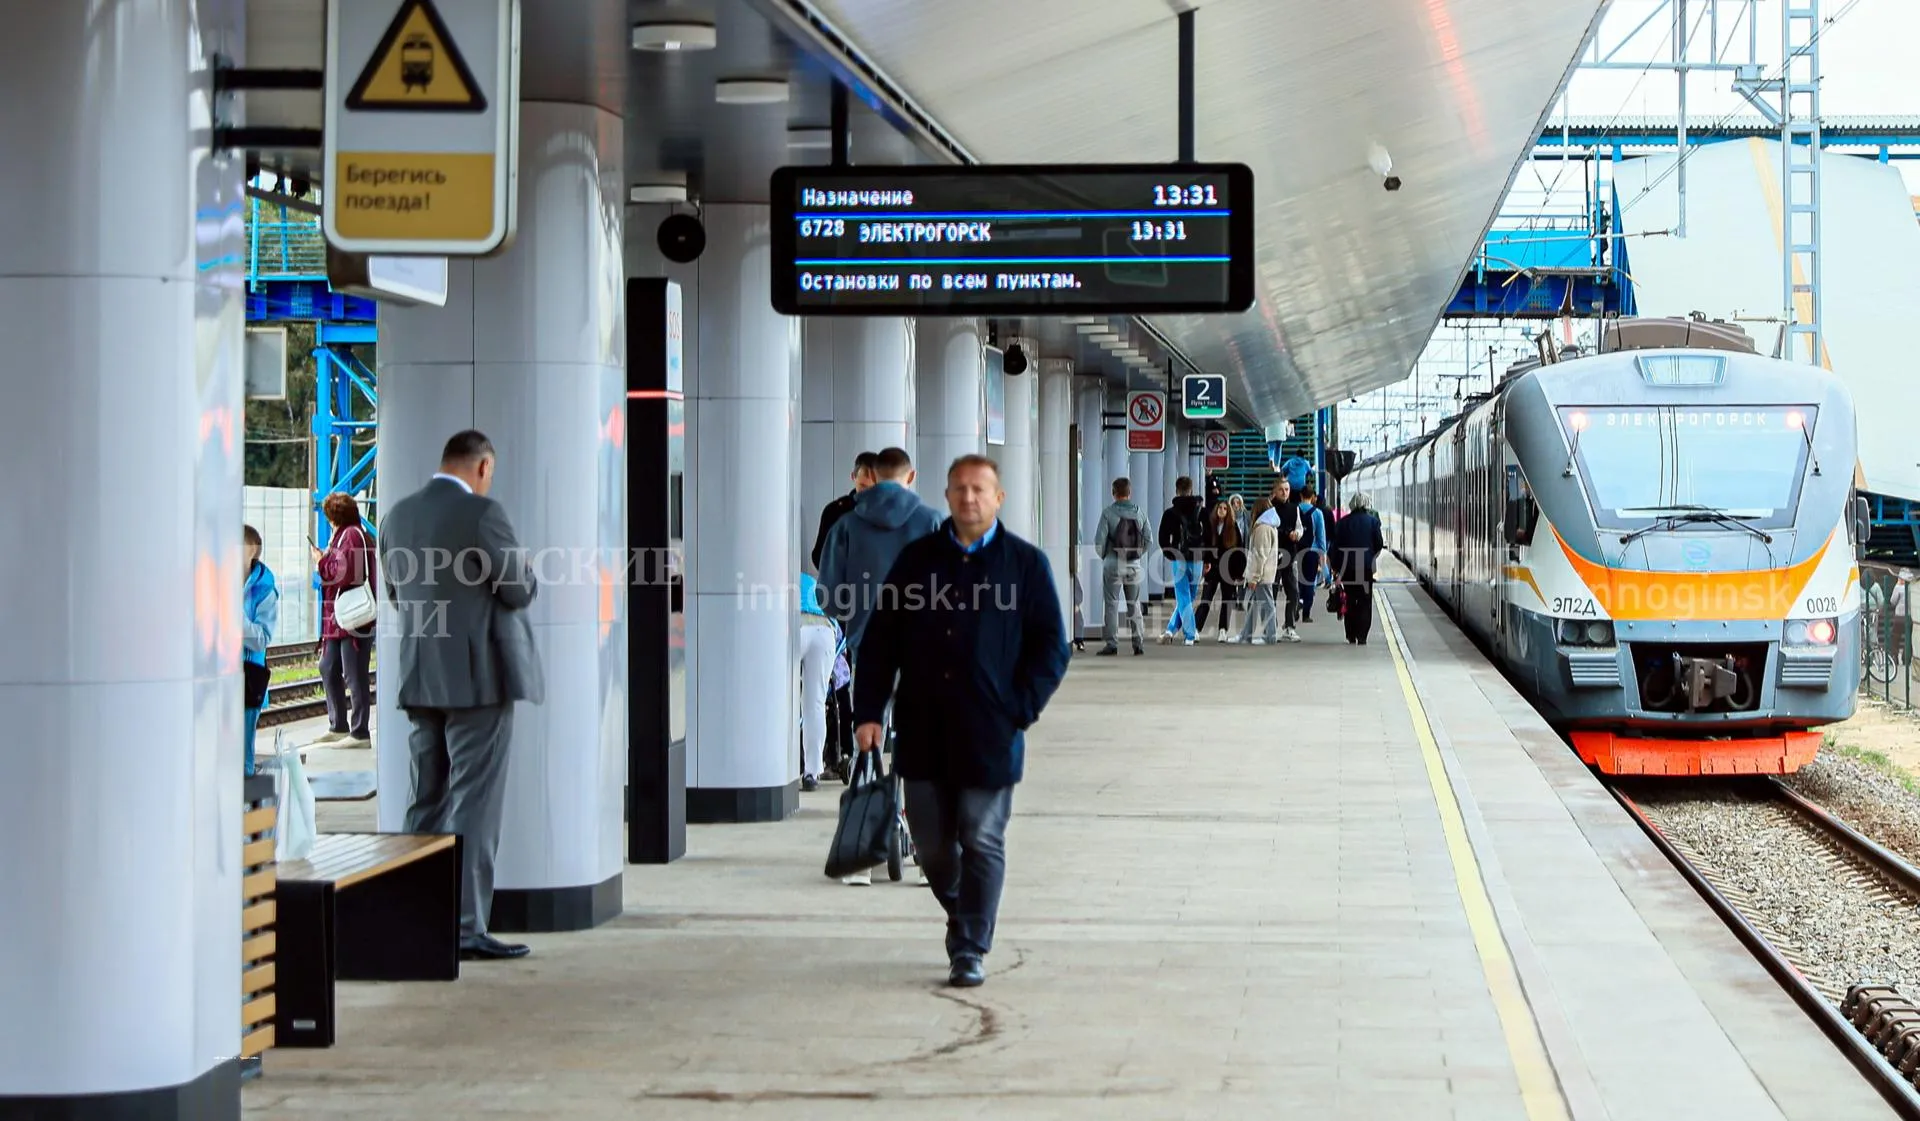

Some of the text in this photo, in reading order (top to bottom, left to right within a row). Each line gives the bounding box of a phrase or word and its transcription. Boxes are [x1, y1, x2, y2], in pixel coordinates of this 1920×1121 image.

[346, 164, 447, 187] Берегись
[346, 192, 431, 213] поезда!
[802, 188, 914, 206] Назначение
[1153, 184, 1218, 206] 13:31
[800, 218, 1187, 243] 6728 ЭЛЕКТРОГОРСК 13:31
[800, 272, 1082, 292] Остановки по всем пунктам.
[1196, 380, 1210, 400] 2
[1606, 412, 1766, 427] ЭЛЕКТРОГОРСК
[1552, 597, 1597, 616] ЭП2Д
[1806, 596, 1837, 614] 0028
